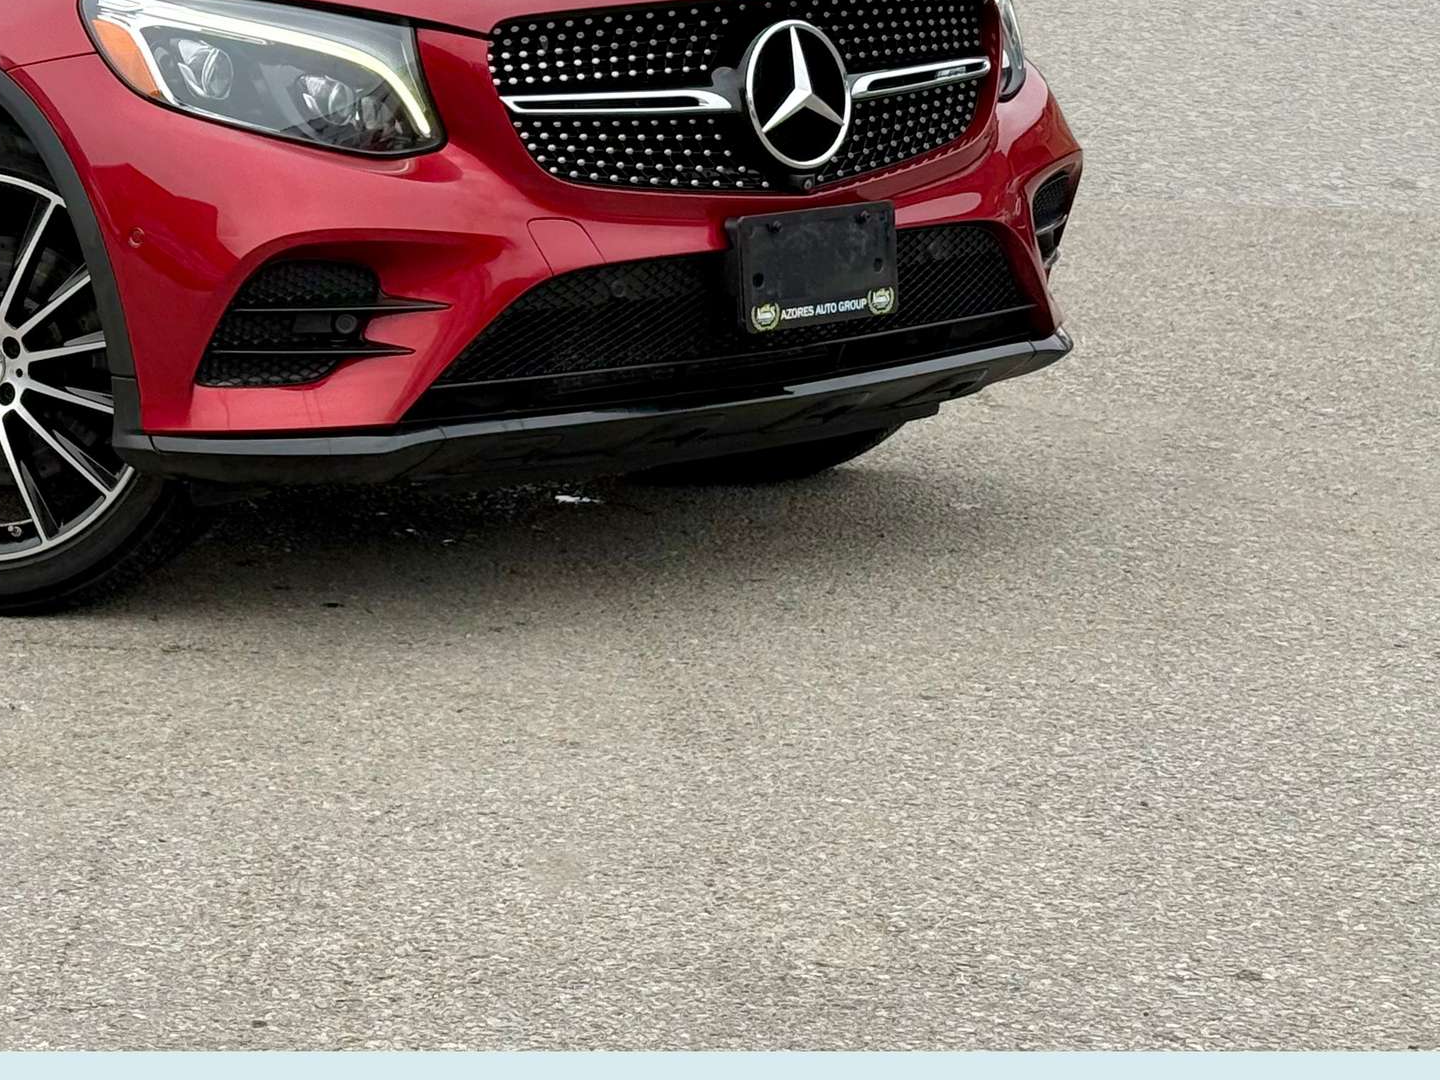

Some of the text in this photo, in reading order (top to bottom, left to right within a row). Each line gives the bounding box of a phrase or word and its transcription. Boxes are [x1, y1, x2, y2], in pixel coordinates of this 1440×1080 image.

[781, 307, 814, 320] AZORES
[816, 303, 837, 315] AUTO
[839, 298, 867, 311] GROUP
